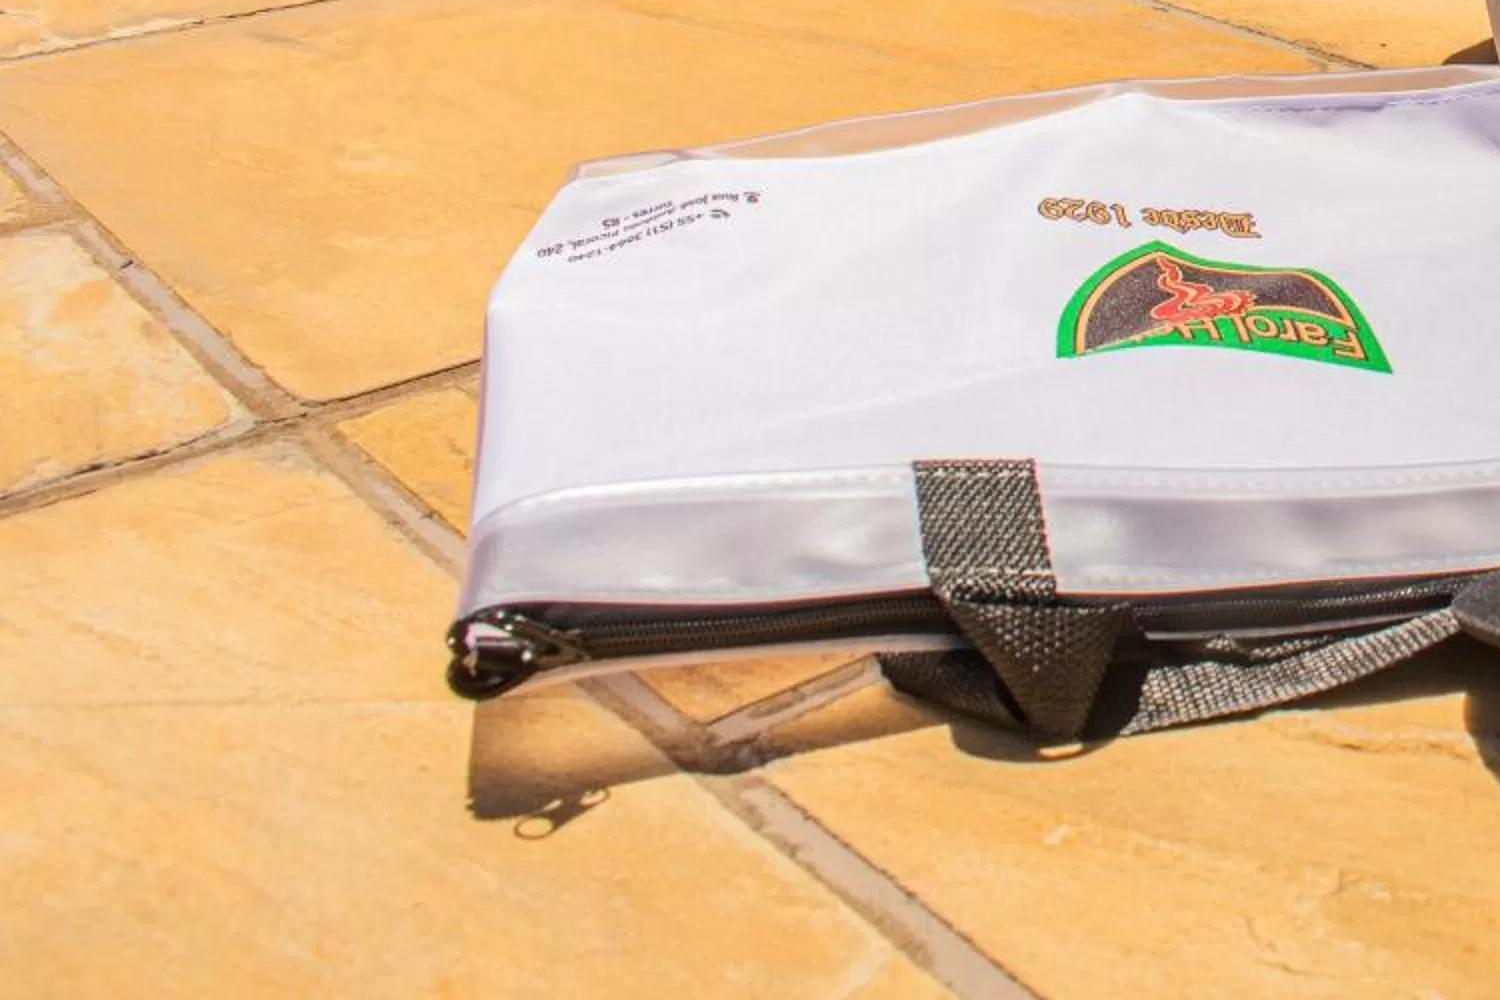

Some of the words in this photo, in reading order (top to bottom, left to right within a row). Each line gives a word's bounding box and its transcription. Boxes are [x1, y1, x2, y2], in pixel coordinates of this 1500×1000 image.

[601, 217, 621, 229] RS
[1037, 197, 1132, 229] 1929
[1140, 207, 1262, 239] Desde
[537, 243, 564, 258] 240
[1235, 314, 1367, 360] Farol
